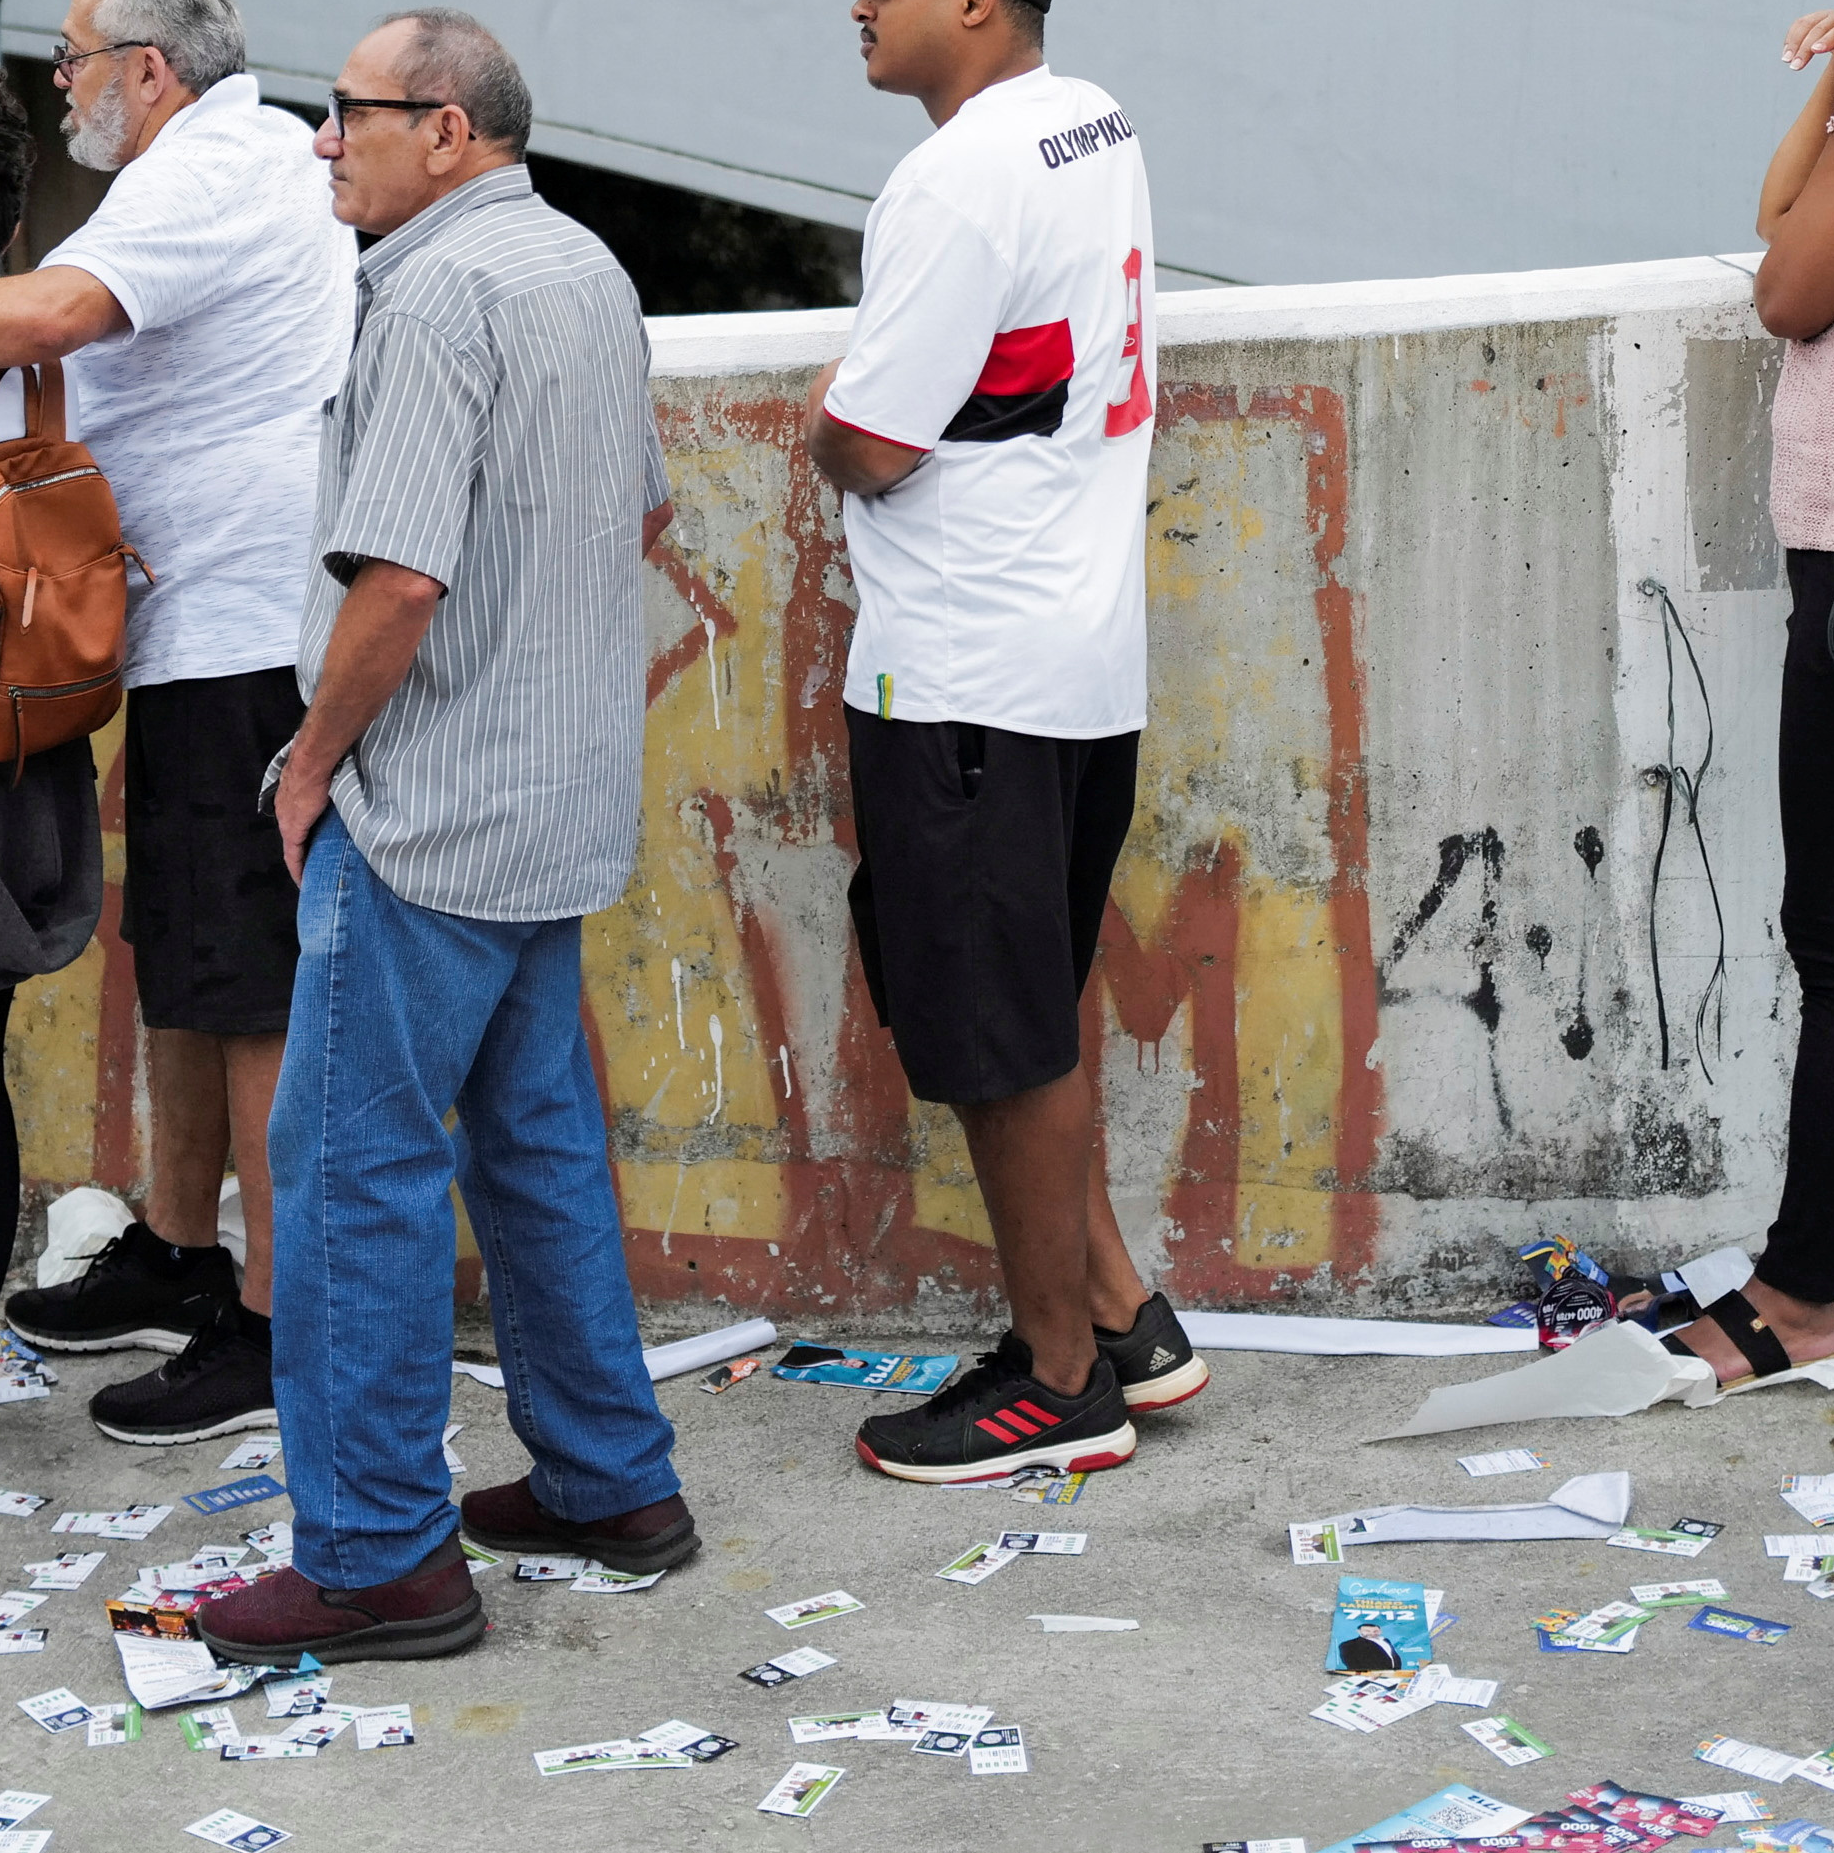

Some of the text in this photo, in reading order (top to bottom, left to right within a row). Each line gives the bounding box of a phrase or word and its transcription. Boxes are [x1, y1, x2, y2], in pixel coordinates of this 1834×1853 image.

[1577, 1306, 1604, 1321] 4000
[1343, 1608, 1416, 1621] 7712
[1679, 1803, 1718, 1817] 4000
[1560, 1822, 1600, 1832] 4000
[1411, 1838, 1450, 1848] 4000
[1480, 1837, 1519, 1848] 4000
